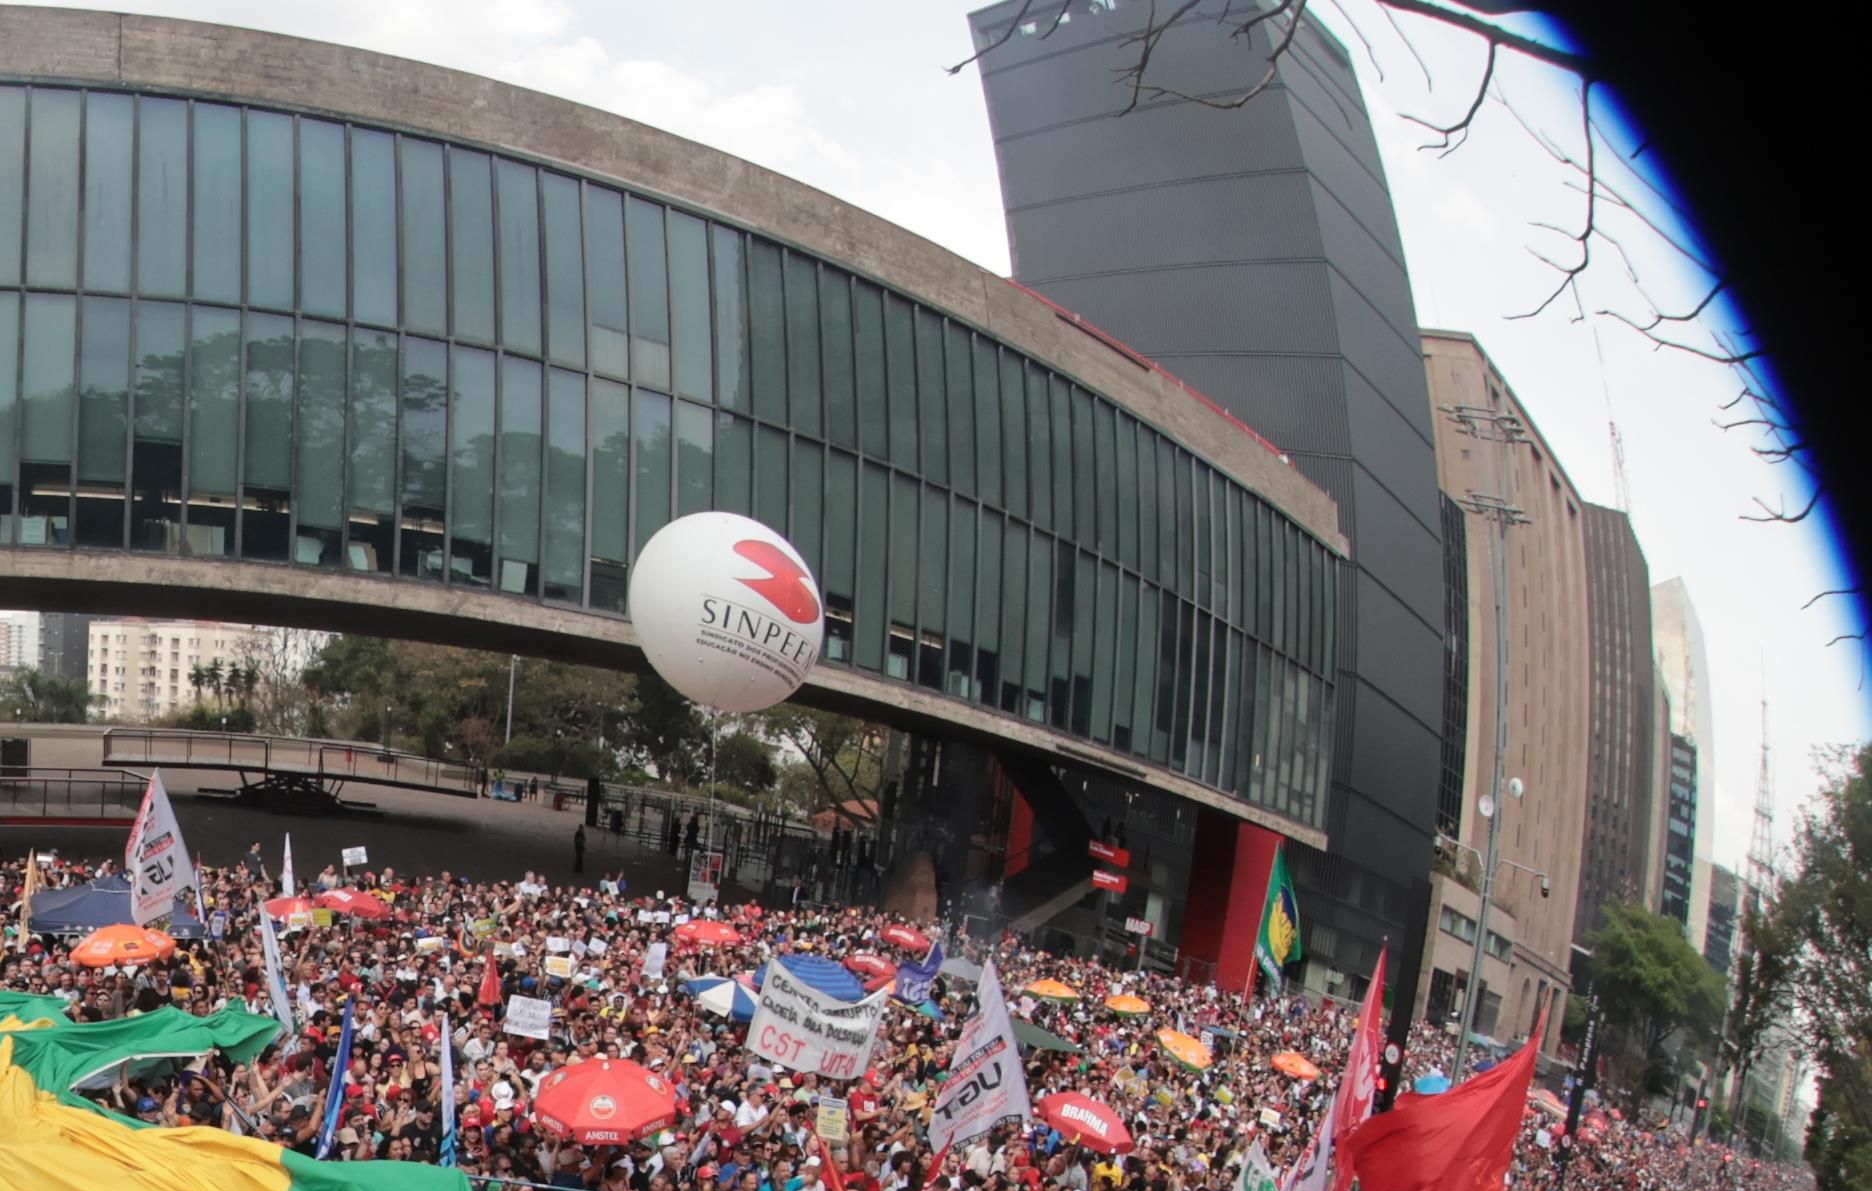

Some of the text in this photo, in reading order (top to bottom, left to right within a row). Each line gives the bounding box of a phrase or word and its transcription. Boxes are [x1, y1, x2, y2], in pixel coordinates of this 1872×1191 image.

[1124, 916, 1151, 936] MASP
[759, 1025, 806, 1062] CST
[541, 1114, 564, 1134] AMSTEL
[641, 1119, 667, 1134] AMSTEL
[1060, 1103, 1108, 1137] BRAHMA
[585, 1130, 619, 1141] AMSTEL
